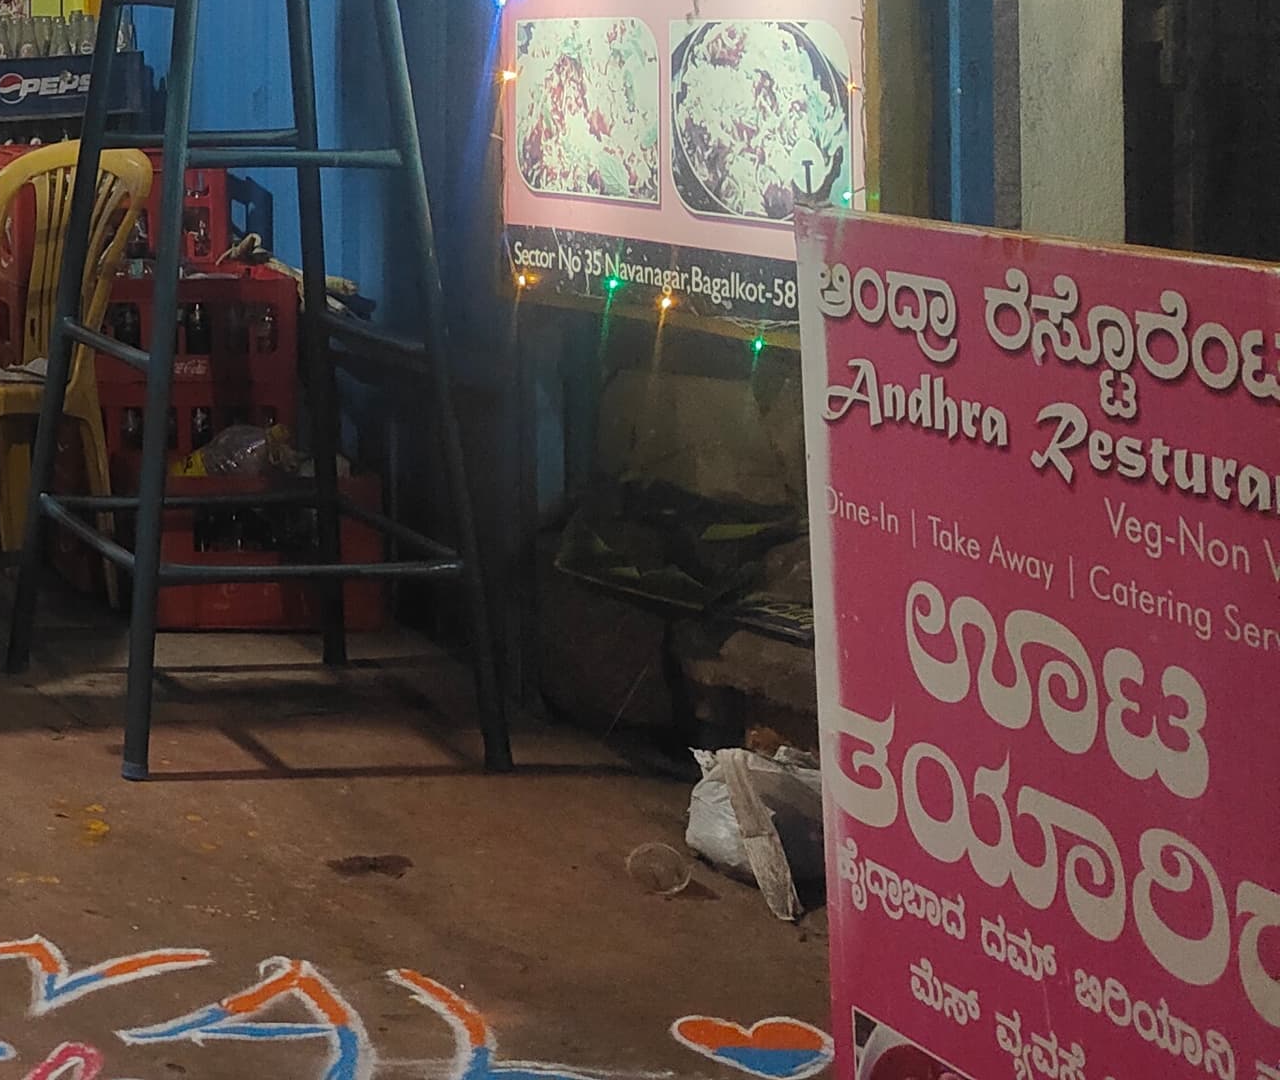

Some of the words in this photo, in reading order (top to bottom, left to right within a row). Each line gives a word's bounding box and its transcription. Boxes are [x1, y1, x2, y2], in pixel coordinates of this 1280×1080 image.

[18, 72, 91, 97] PEPS
[513, 240, 557, 270] Sector
[558, 245, 582, 273] No
[584, 249, 603, 276] 35
[822, 357, 1009, 447] Andhra
[1030, 401, 1280, 515] Restura
[825, 485, 900, 535] Dine-In
[927, 514, 981, 561] Take
[988, 535, 1054, 591] Away
[1088, 564, 1213, 641] Catering
[1103, 496, 1251, 575] Veg-Non
[906, 580, 1210, 800] ಊಟ
